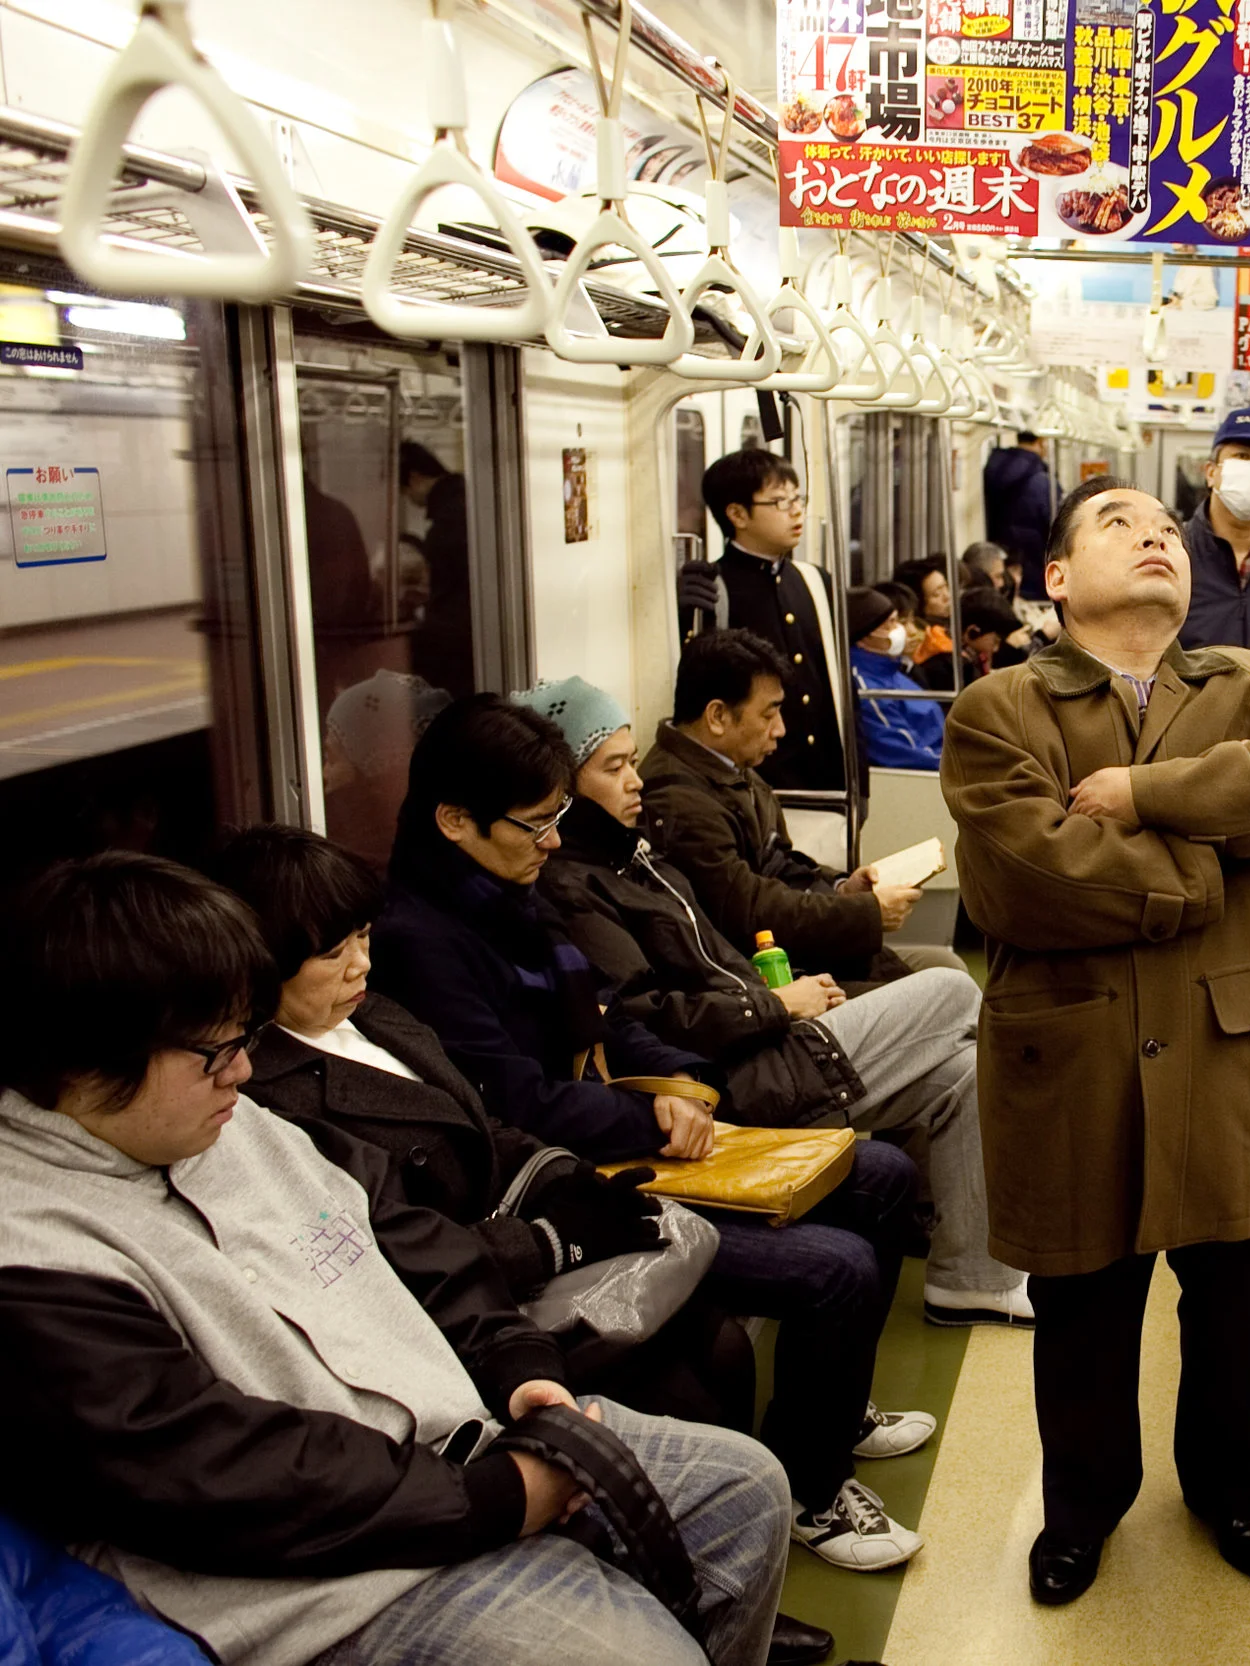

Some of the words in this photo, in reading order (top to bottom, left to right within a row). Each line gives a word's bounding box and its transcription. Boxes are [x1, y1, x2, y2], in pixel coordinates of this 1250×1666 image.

[967, 77, 1013, 93] 2010年
[967, 93, 1063, 114] チョコレート
[968, 113, 1014, 128] BEST
[1018, 113, 1046, 129] 37
[1143, 0, 1236, 236] グルメ
[784, 160, 1035, 217] おとなの週末
[943, 214, 966, 231] 2月号
[35, 466, 76, 484] お願い
